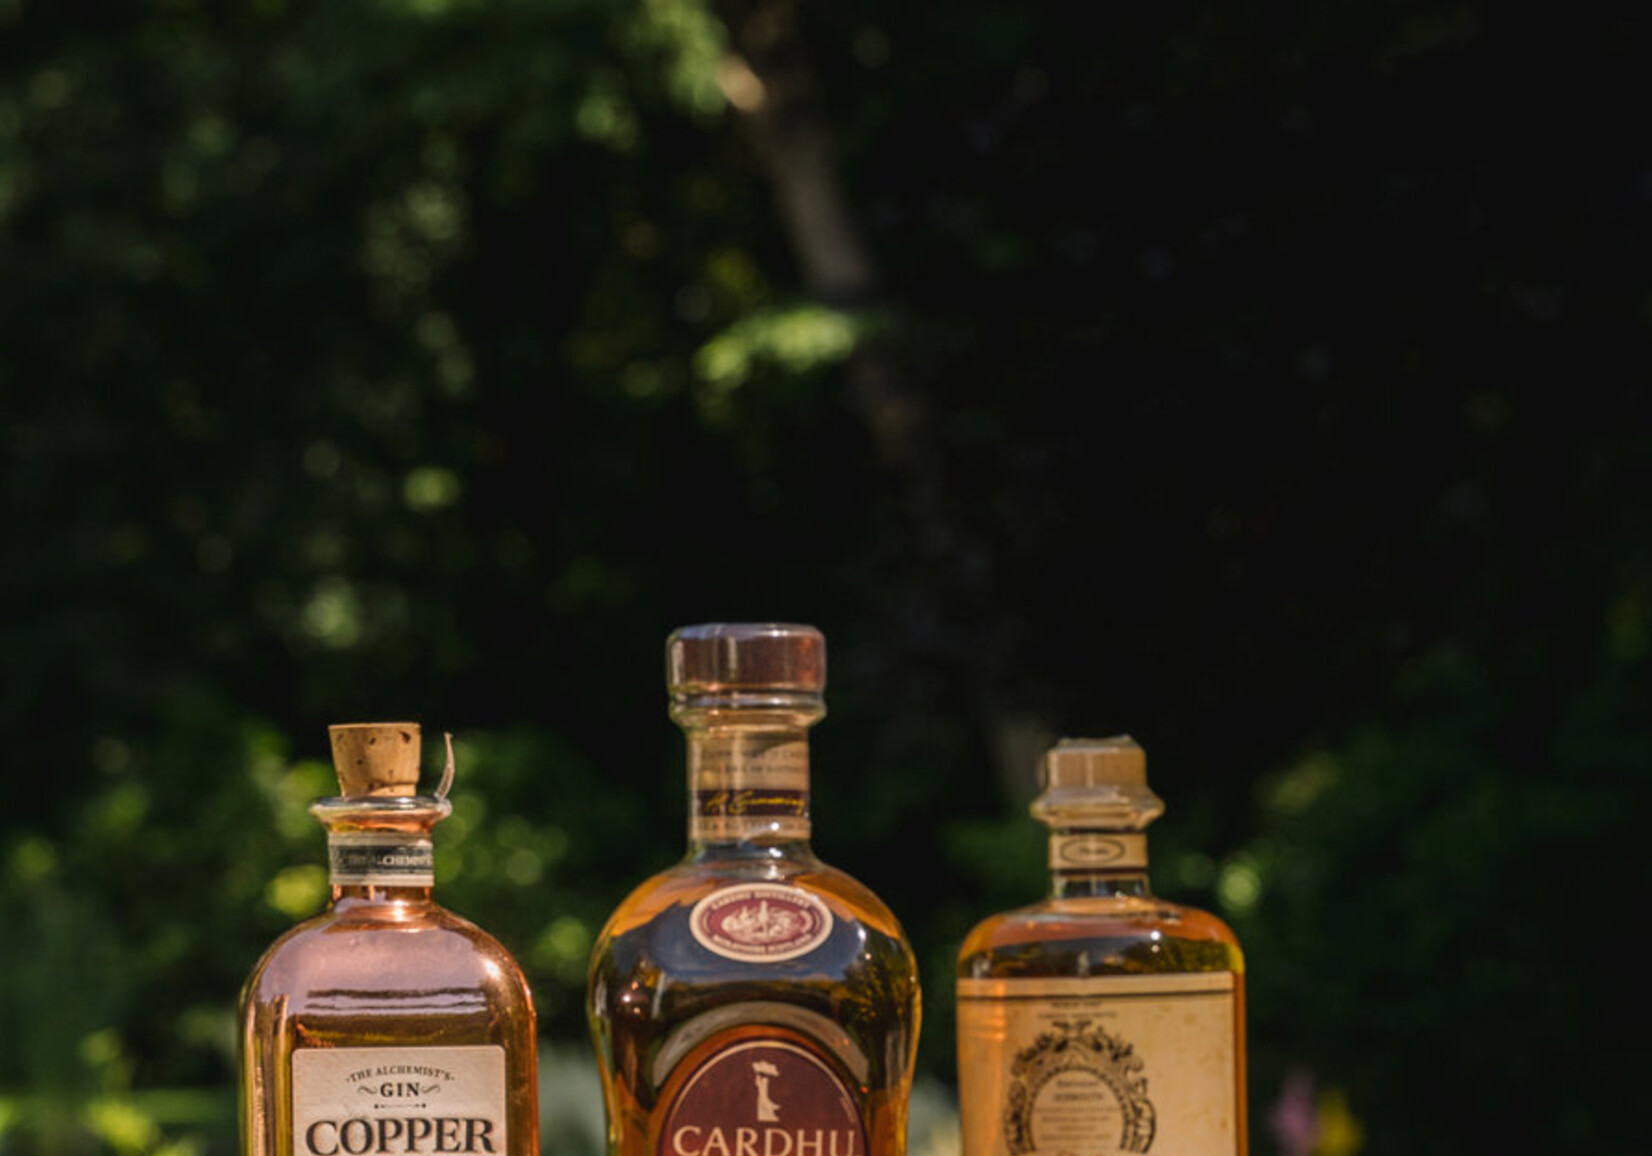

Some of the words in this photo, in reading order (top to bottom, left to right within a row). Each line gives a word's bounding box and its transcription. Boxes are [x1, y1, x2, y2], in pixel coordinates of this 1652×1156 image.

[350, 1069, 371, 1082] THE
[376, 1065, 451, 1081] ALCHEMIST'S
[380, 1082, 420, 1097] GIN
[305, 1117, 496, 1156] COPPER
